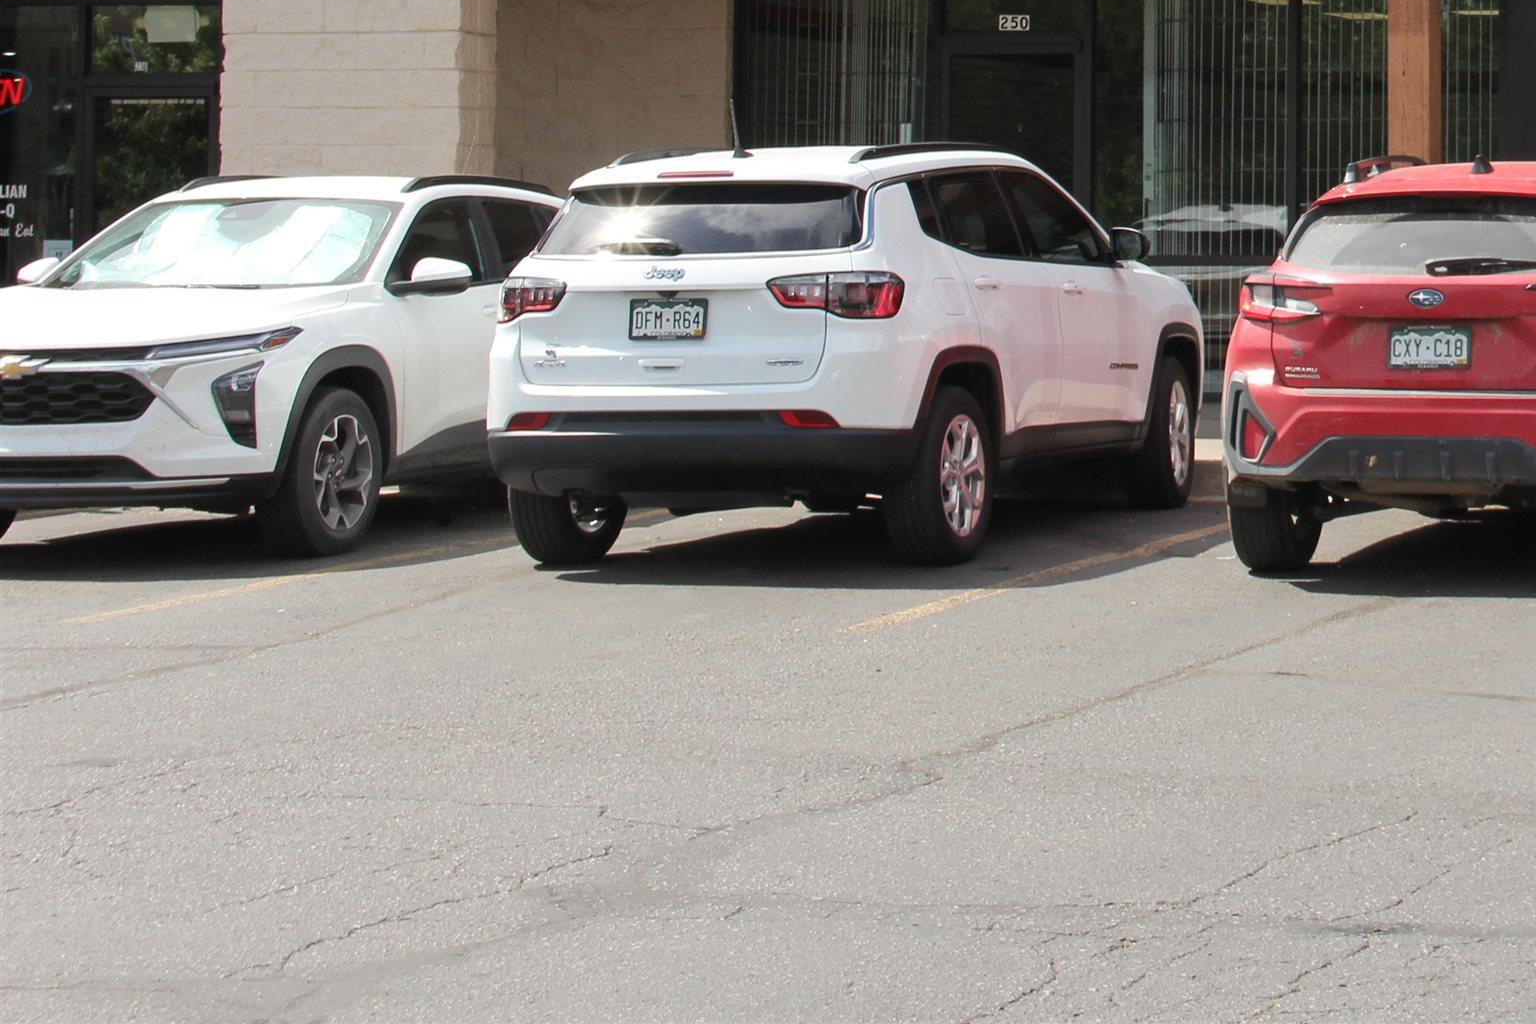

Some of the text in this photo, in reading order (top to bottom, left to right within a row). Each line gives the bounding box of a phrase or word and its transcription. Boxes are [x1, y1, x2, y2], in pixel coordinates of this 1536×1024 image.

[1000, 16, 1029, 30] 250
[15, 223, 34, 238] Eat
[643, 265, 686, 282] Jeep
